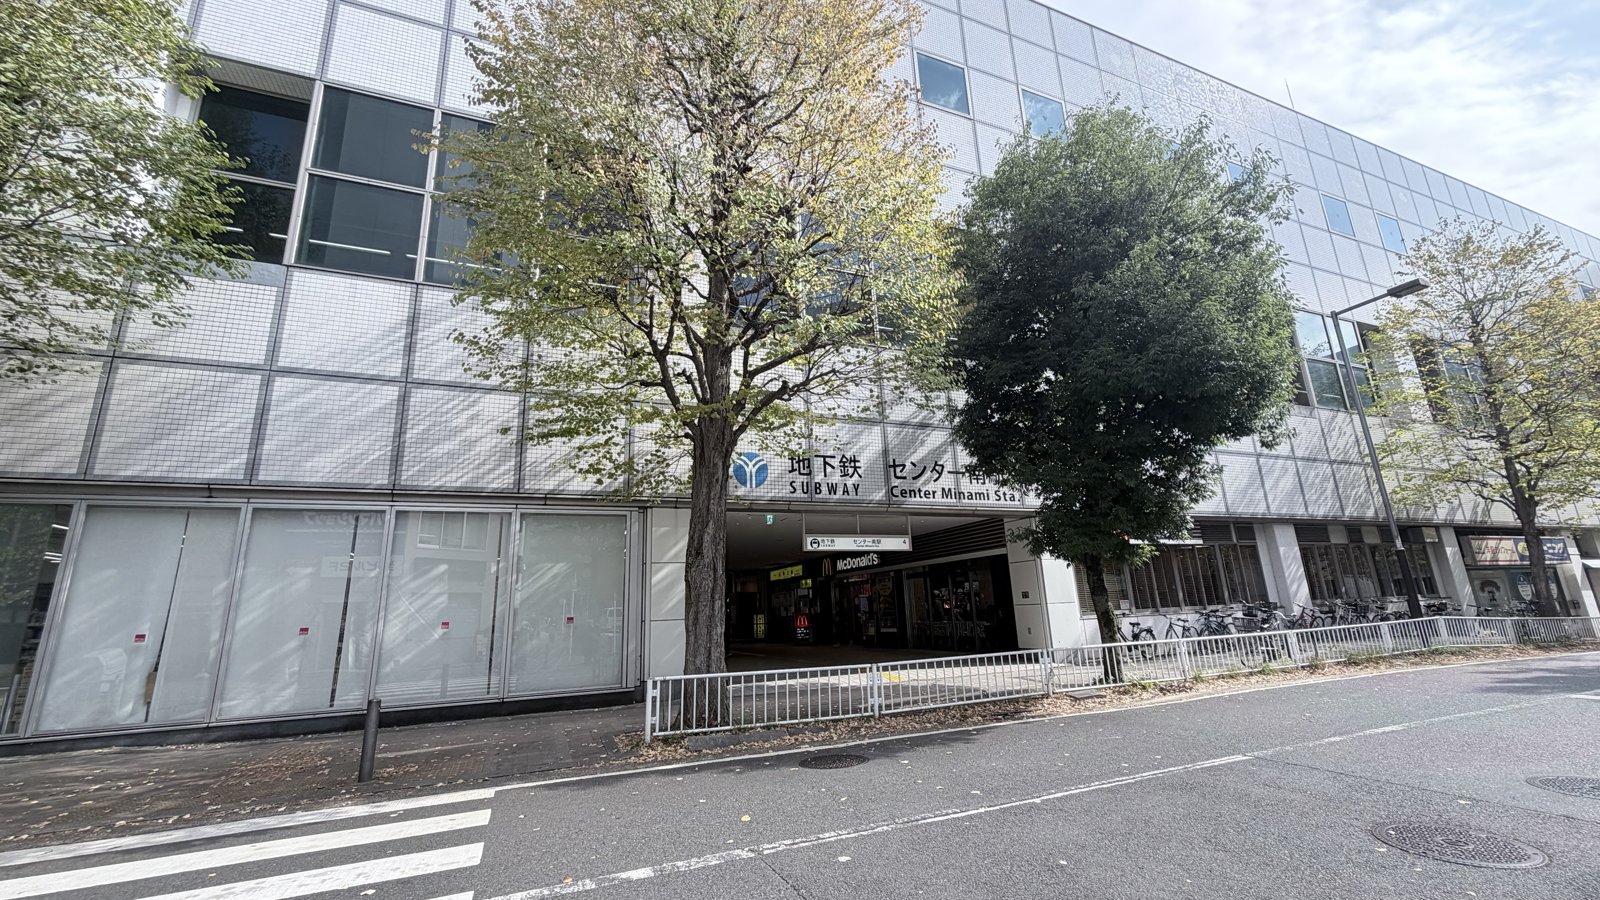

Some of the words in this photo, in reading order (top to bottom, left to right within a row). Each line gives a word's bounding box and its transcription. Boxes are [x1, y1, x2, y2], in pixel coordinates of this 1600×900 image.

[788, 454, 863, 479] 地下鉄
[789, 480, 860, 496] SUBWAY
[890, 485, 937, 499] Center
[941, 487, 990, 501] Minami
[994, 489, 1021, 502] Sta.
[836, 552, 879, 572] McDonald's
